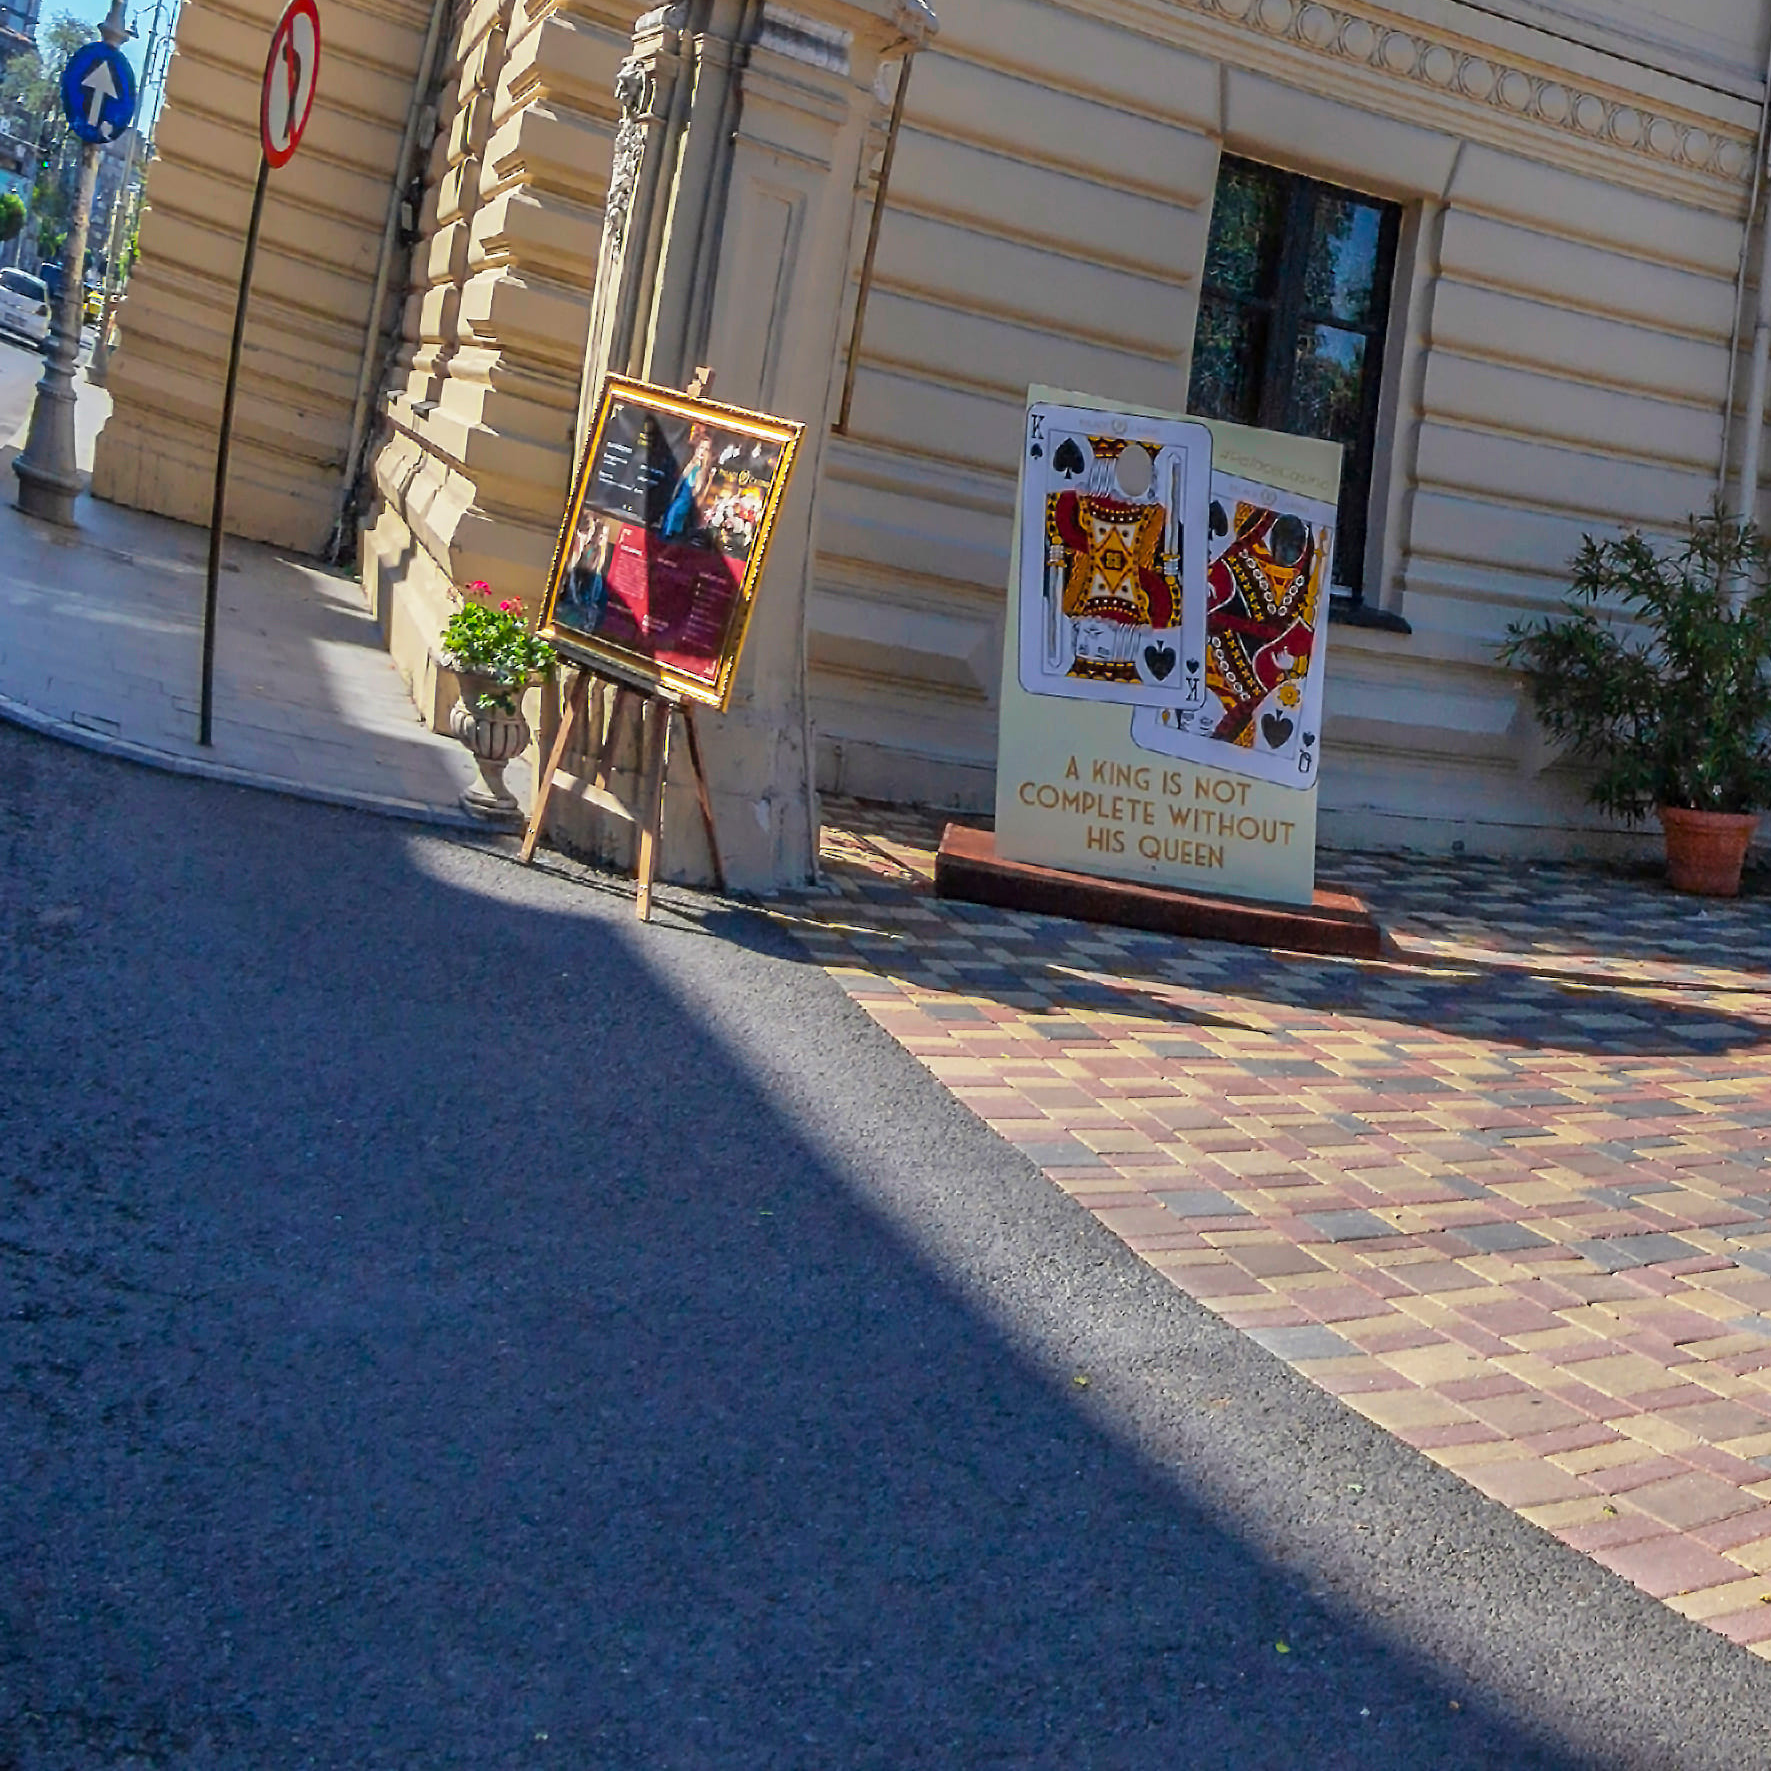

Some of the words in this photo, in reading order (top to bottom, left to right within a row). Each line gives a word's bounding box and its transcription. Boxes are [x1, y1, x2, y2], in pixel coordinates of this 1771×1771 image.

[1031, 414, 1045, 439] K
[1065, 755, 1079, 780] A
[1092, 759, 1150, 791] KING
[1162, 771, 1182, 796] IS
[1195, 777, 1252, 806] NOT
[1019, 782, 1155, 826] COMPLETE
[1169, 804, 1295, 845] WITHOUT
[1087, 825, 1125, 853] HIS
[1138, 834, 1225, 869] QUEEN
